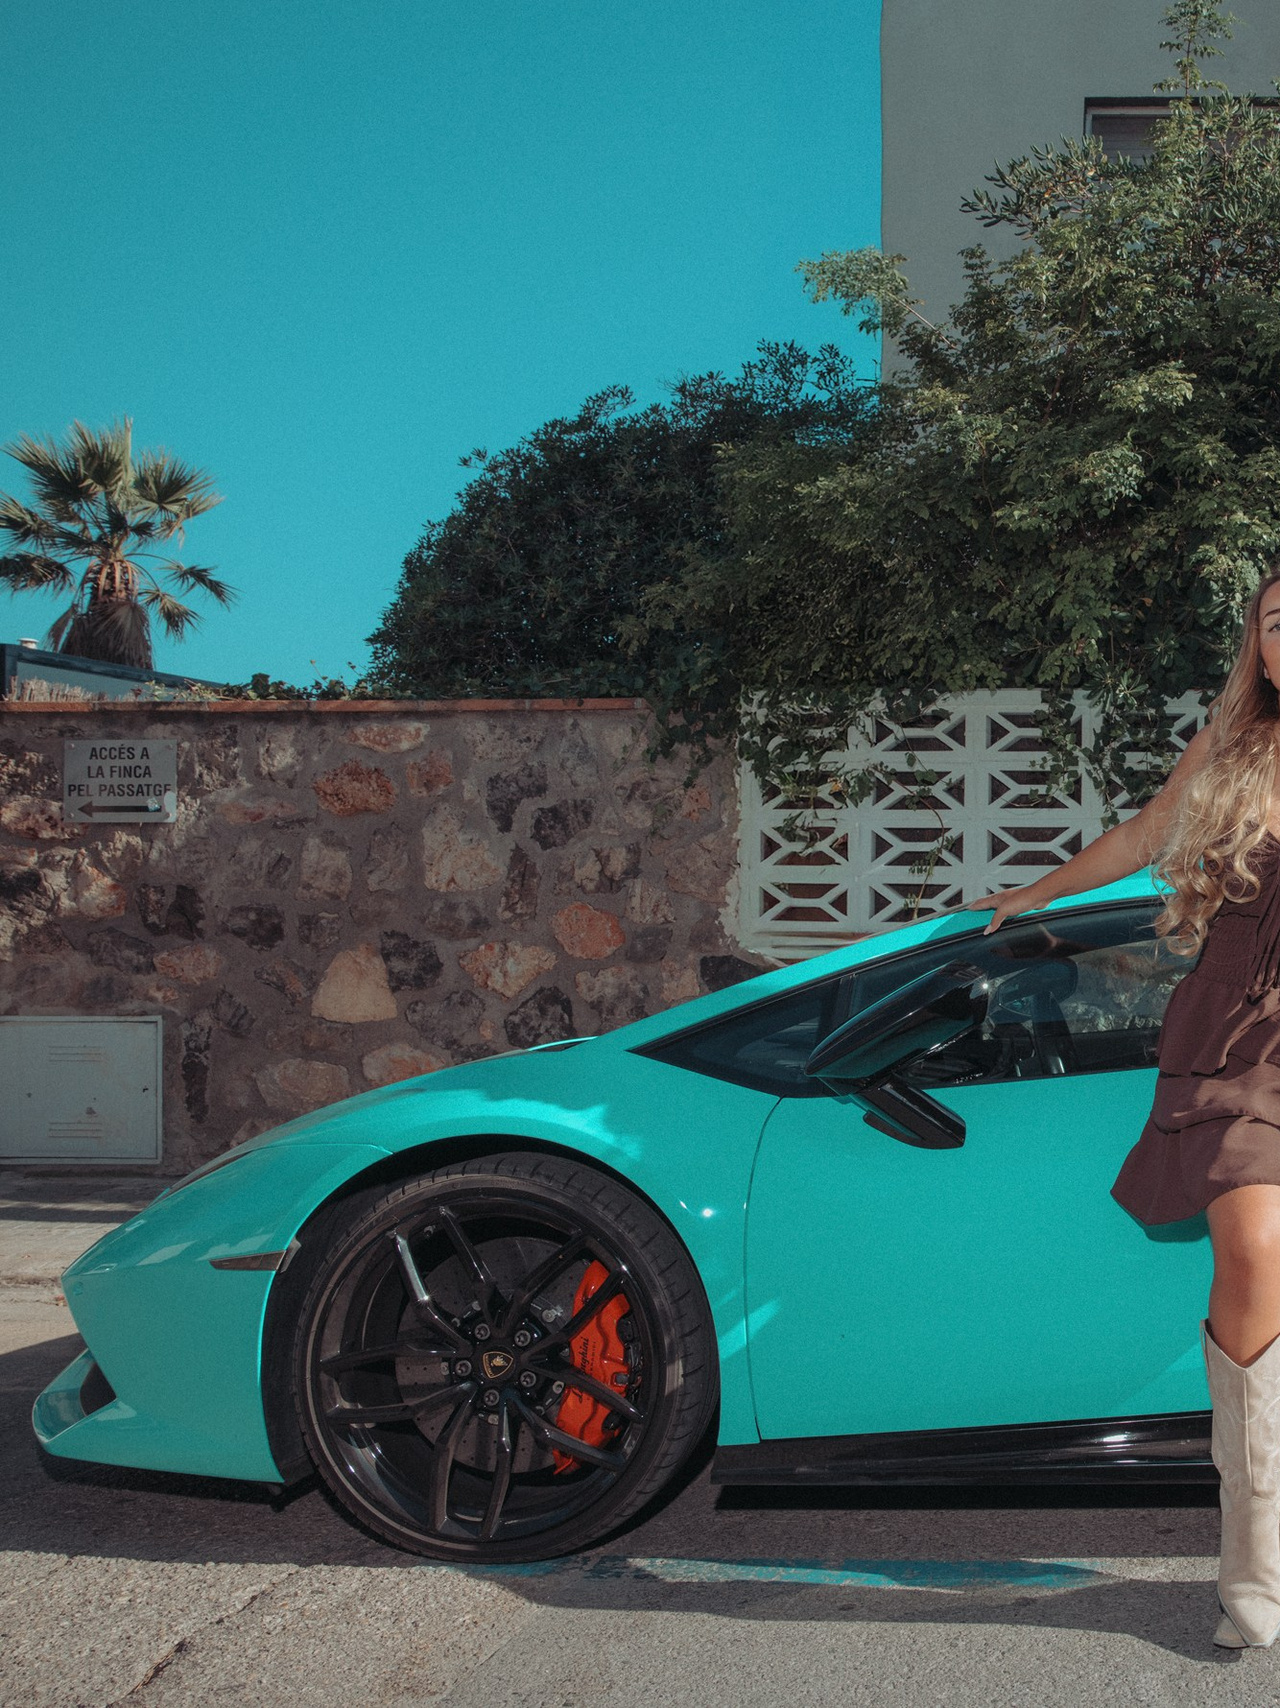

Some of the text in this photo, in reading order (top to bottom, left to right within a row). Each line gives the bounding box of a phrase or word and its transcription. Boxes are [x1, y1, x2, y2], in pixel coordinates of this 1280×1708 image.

[89, 743, 150, 760] ACCÉS A
[87, 765, 152, 778] LA FINCA
[68, 784, 94, 797] PEL
